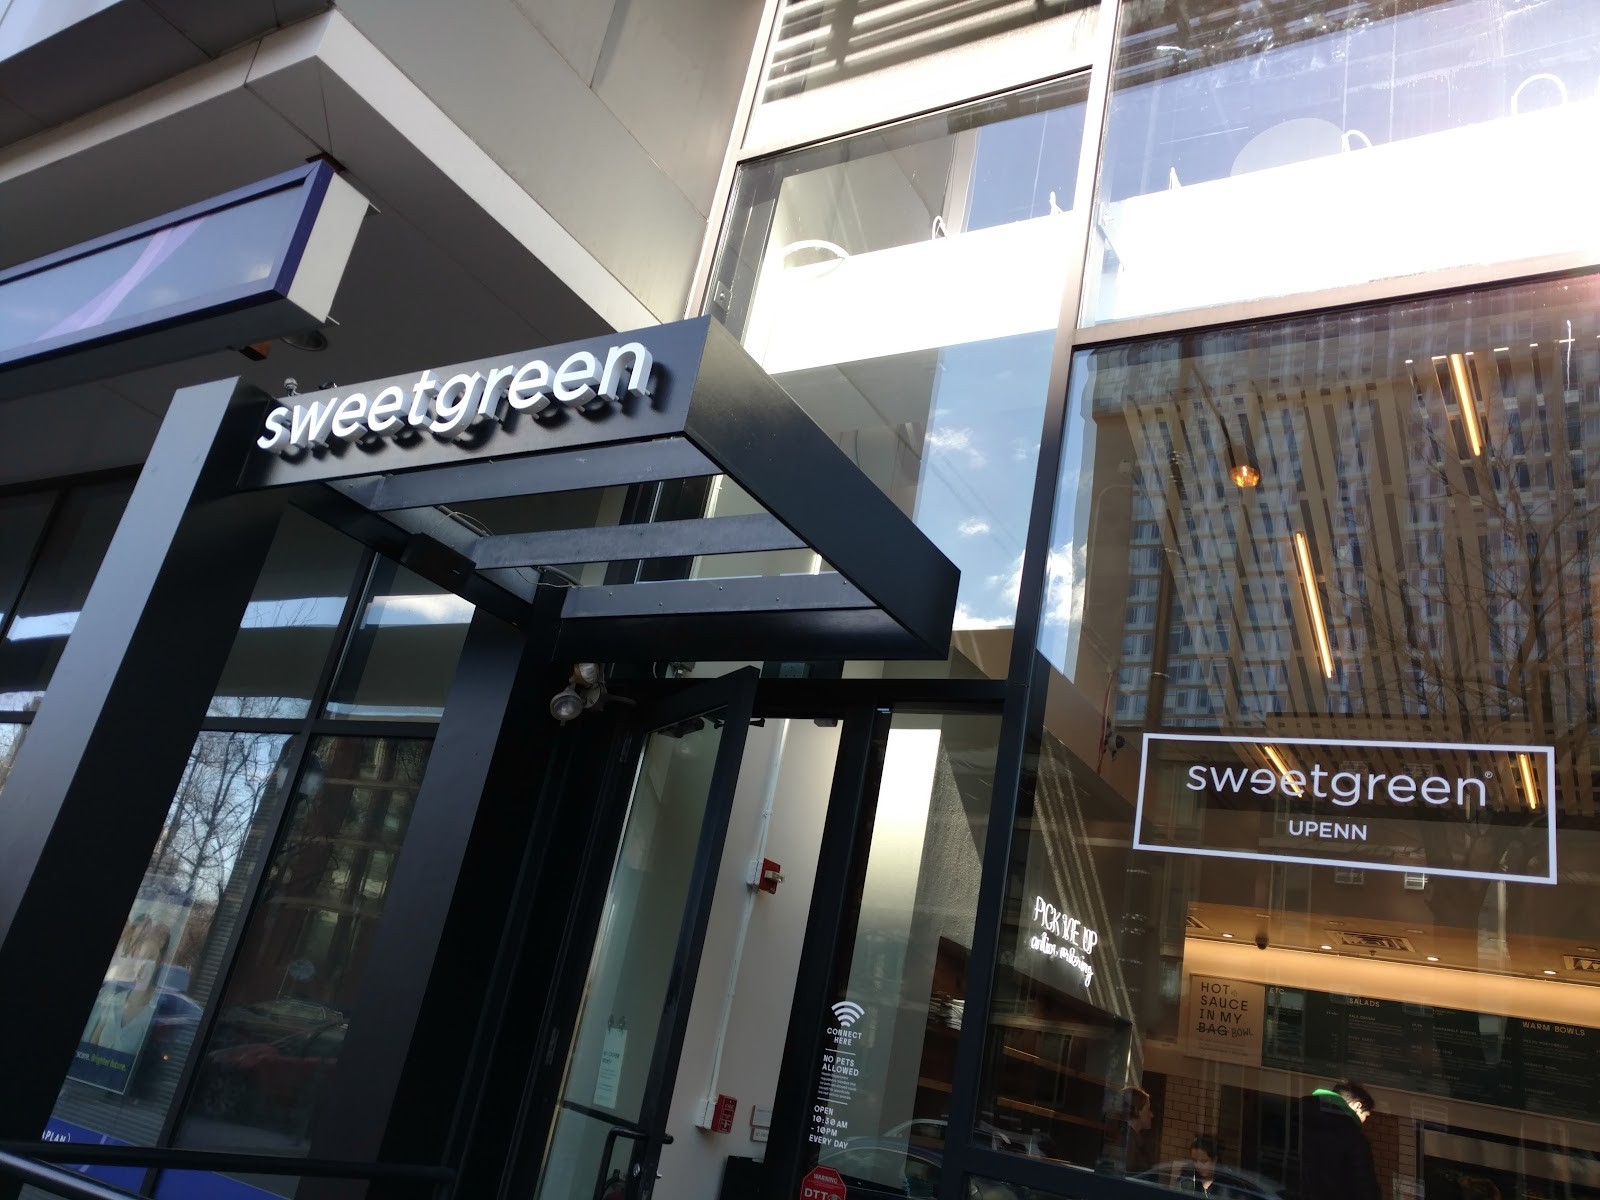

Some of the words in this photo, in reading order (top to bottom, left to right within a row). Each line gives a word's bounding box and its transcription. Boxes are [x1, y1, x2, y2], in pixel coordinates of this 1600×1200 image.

[257, 340, 653, 454] sweetgreen
[1186, 764, 1487, 807] sweetgreen
[1288, 820, 1368, 841] UPENN
[1033, 896, 1061, 937] PICK
[1082, 926, 1098, 954] UP
[1201, 982, 1230, 995] HOT
[1200, 995, 1248, 1012] SAUCE
[1348, 997, 1381, 1008] SALADS
[1199, 1008, 1215, 1021] IN
[1220, 1011, 1242, 1024] MY
[826, 1027, 862, 1039] CONNECT
[1198, 1022, 1228, 1036] BAG
[1231, 1027, 1254, 1038] BOWL
[1522, 1021, 1551, 1032] WARM
[1554, 1025, 1586, 1037] BOWLS
[833, 1036, 852, 1046] HERE
[823, 1054, 834, 1063] NO
[836, 1057, 855, 1067] PETS
[822, 1063, 859, 1076] ALLOWED
[814, 1105, 834, 1115] OPEN
[809, 1134, 832, 1146] EVERY
[833, 1140, 849, 1149] DAY
[813, 1173, 838, 1184] WARNING
